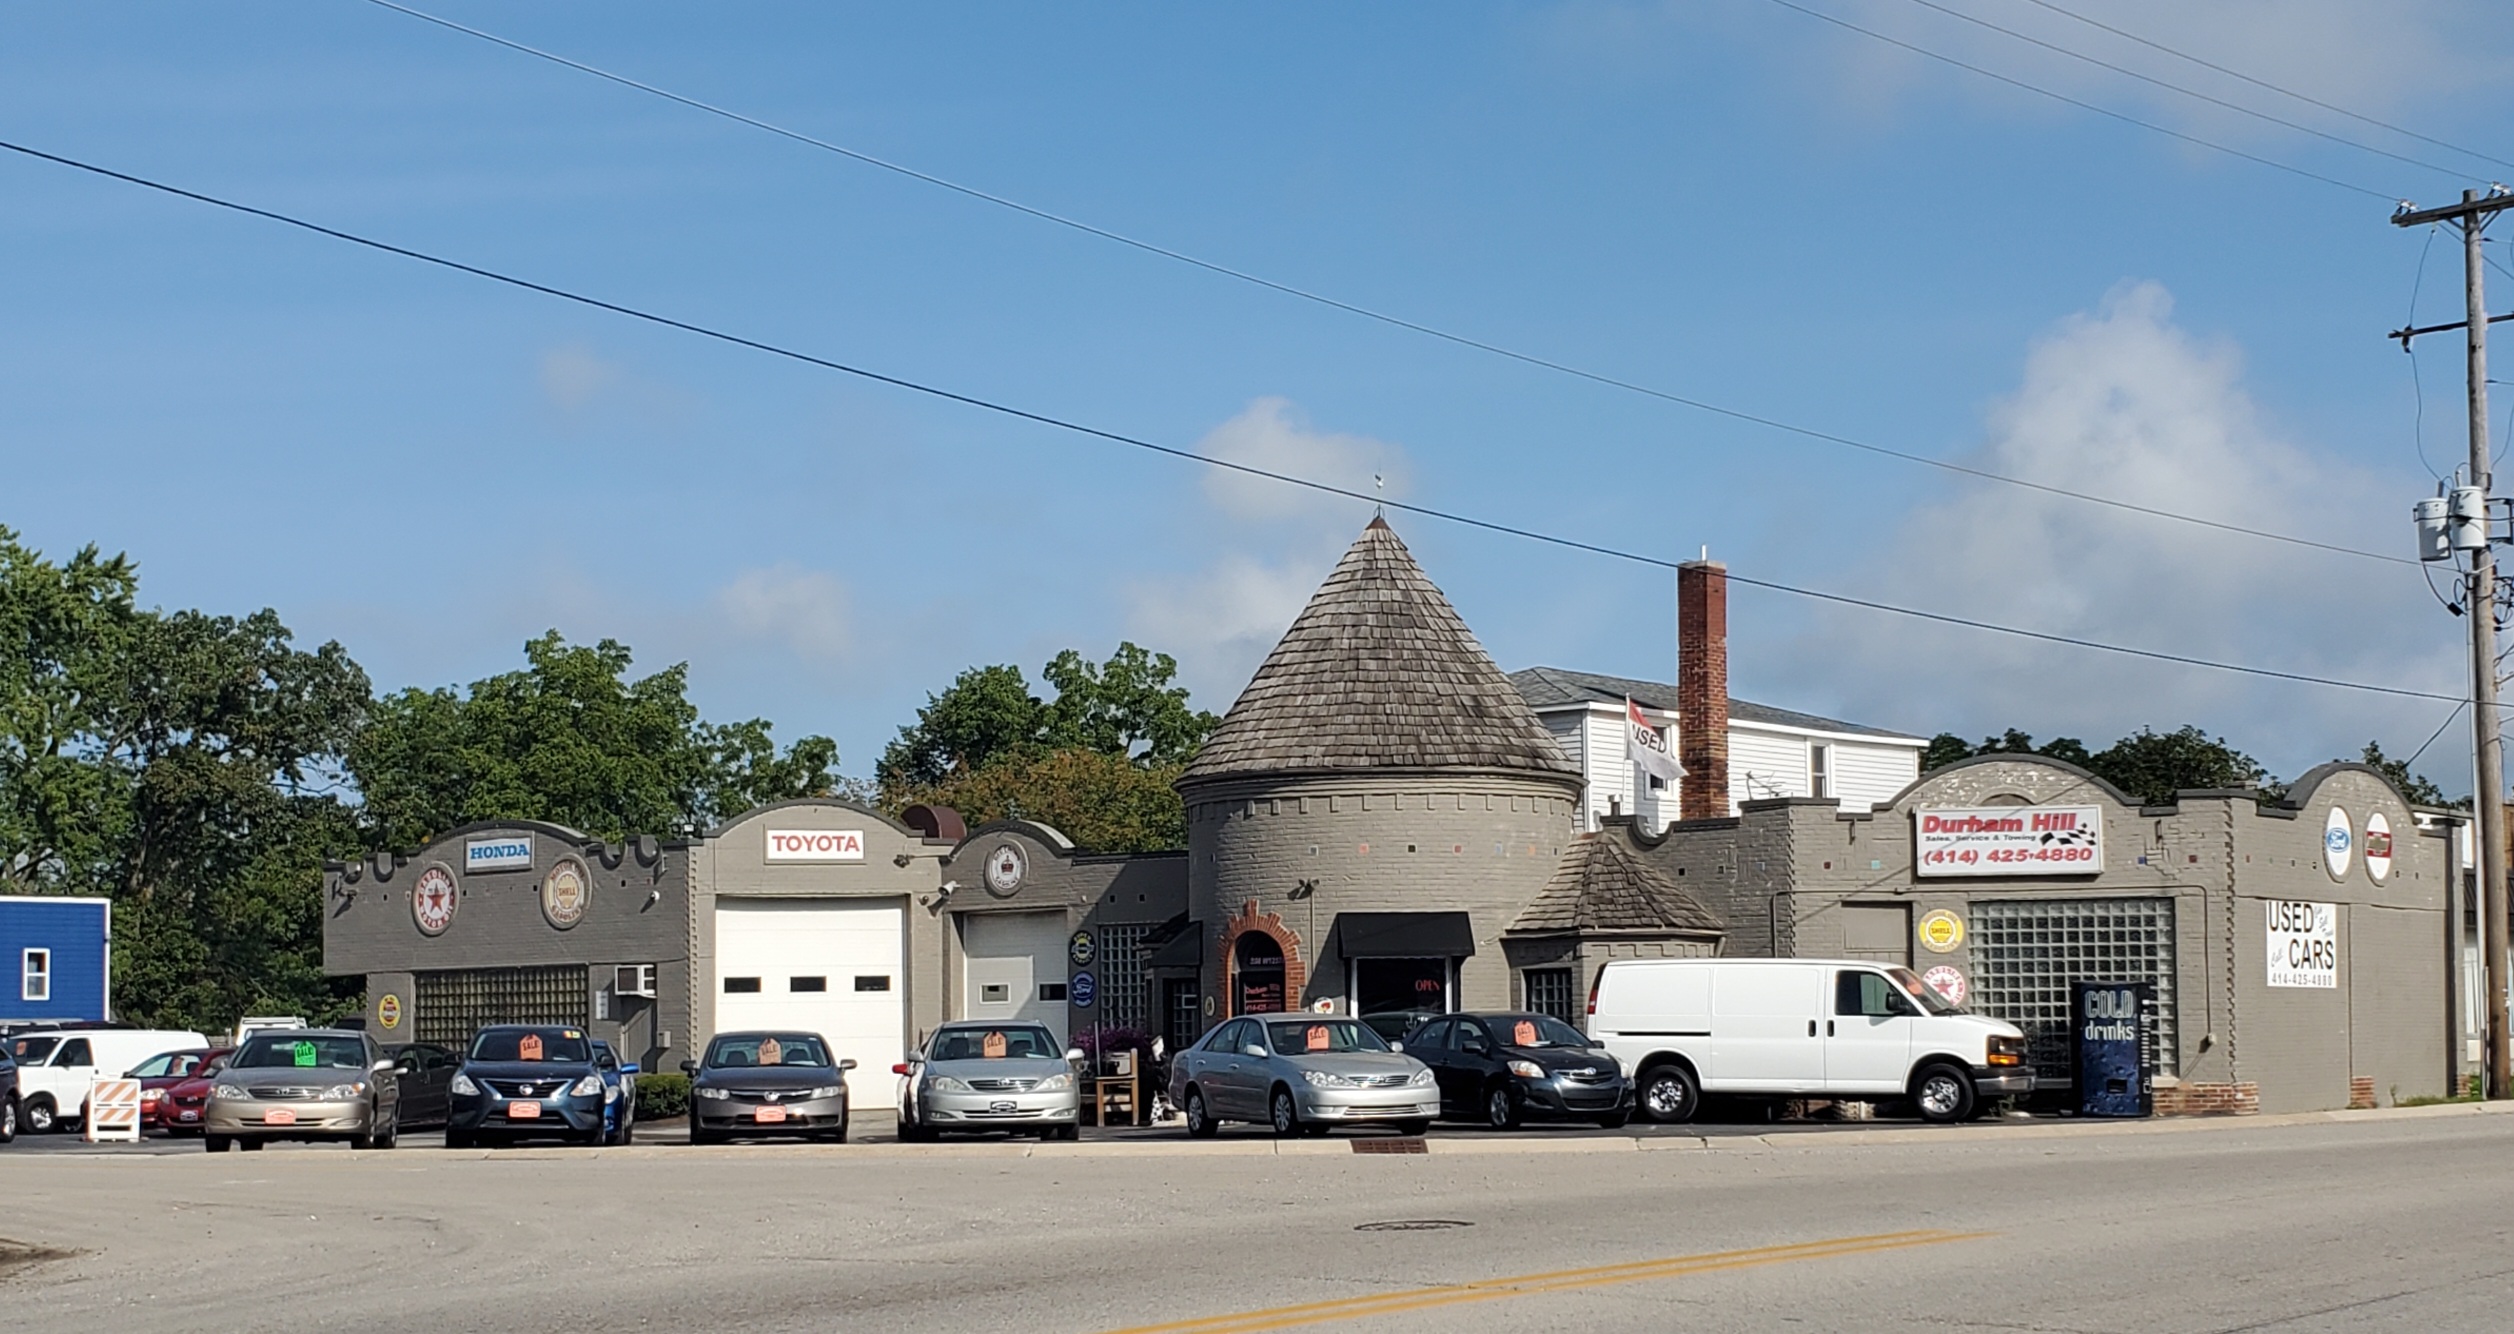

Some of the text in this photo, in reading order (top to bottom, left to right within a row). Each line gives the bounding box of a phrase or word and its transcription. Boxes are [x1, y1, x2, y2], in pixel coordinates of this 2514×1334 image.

[1632, 724, 1666, 753] USED
[1922, 813, 2077, 833] Durham Hill
[772, 835, 860, 852] TOYOTA
[2004, 834, 2036, 842] Towing
[470, 844, 529, 859] HONDA
[1924, 848, 2092, 866] (414) 425-4880
[558, 886, 576, 897] SHELL
[2268, 901, 2314, 933] USED
[2289, 938, 2334, 970] CARS
[1415, 979, 1440, 991] OPEN
[2085, 990, 2134, 1018] COLD
[2085, 1020, 2134, 1040] drinks
